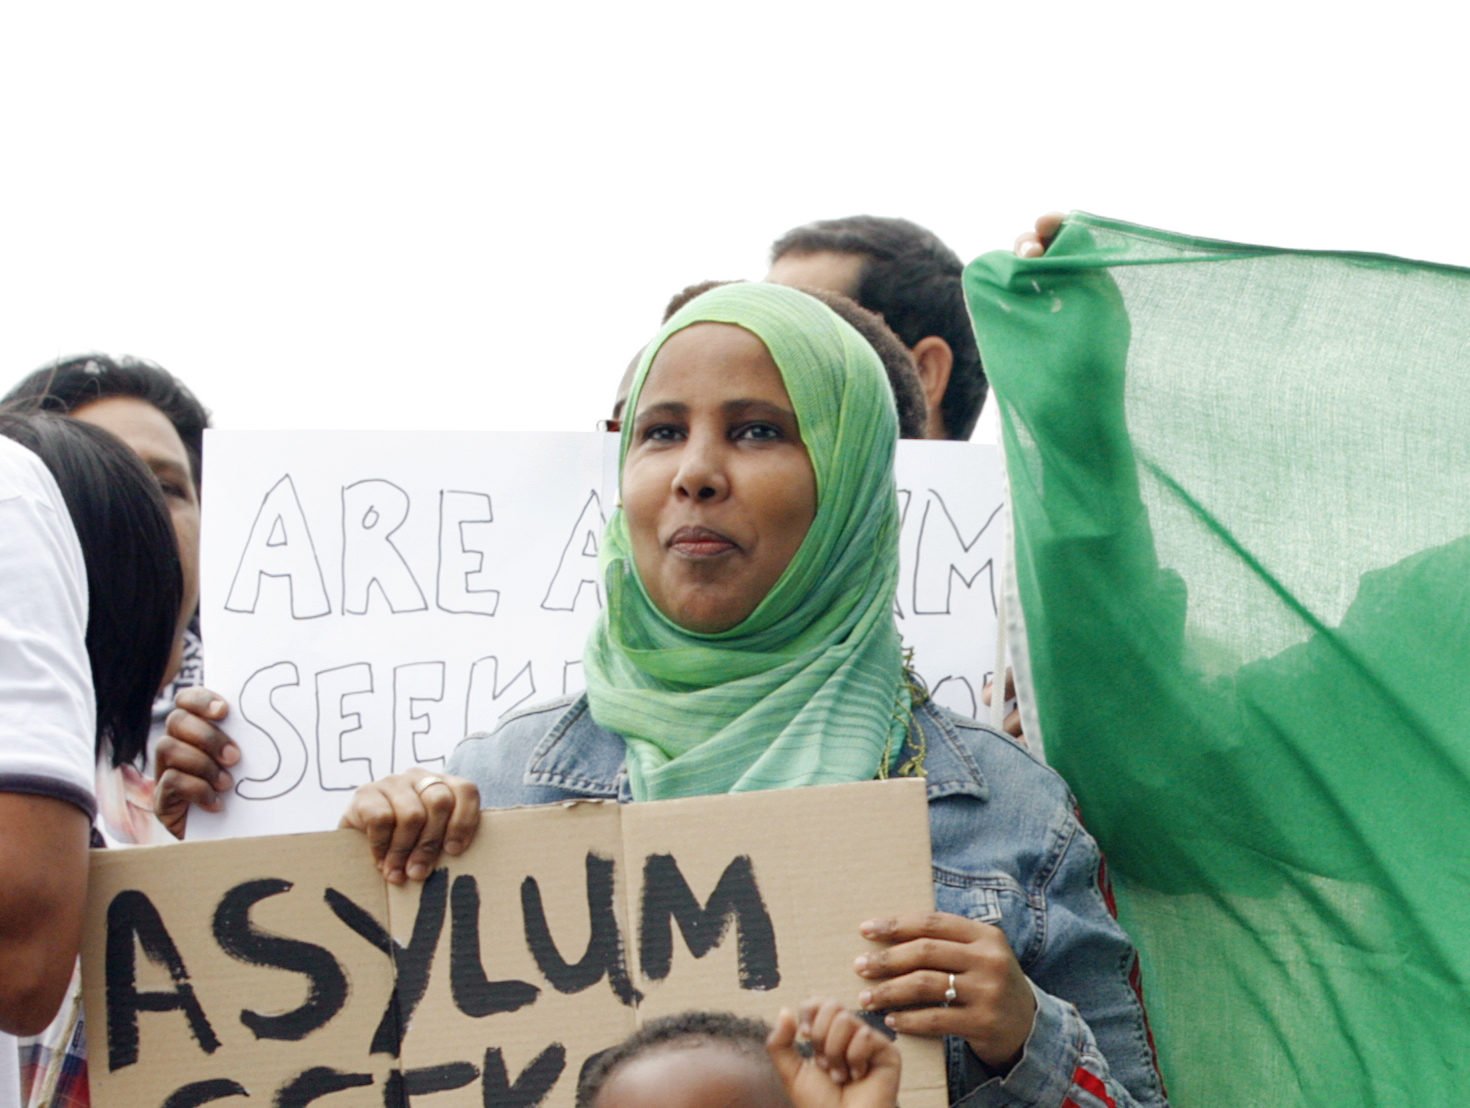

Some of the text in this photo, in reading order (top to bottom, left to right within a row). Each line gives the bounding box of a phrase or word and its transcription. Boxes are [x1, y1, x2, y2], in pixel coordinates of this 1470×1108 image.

[223, 473, 501, 620] ARE
[234, 655, 582, 801] SEEK
[105, 850, 781, 1073] ASYLUM
